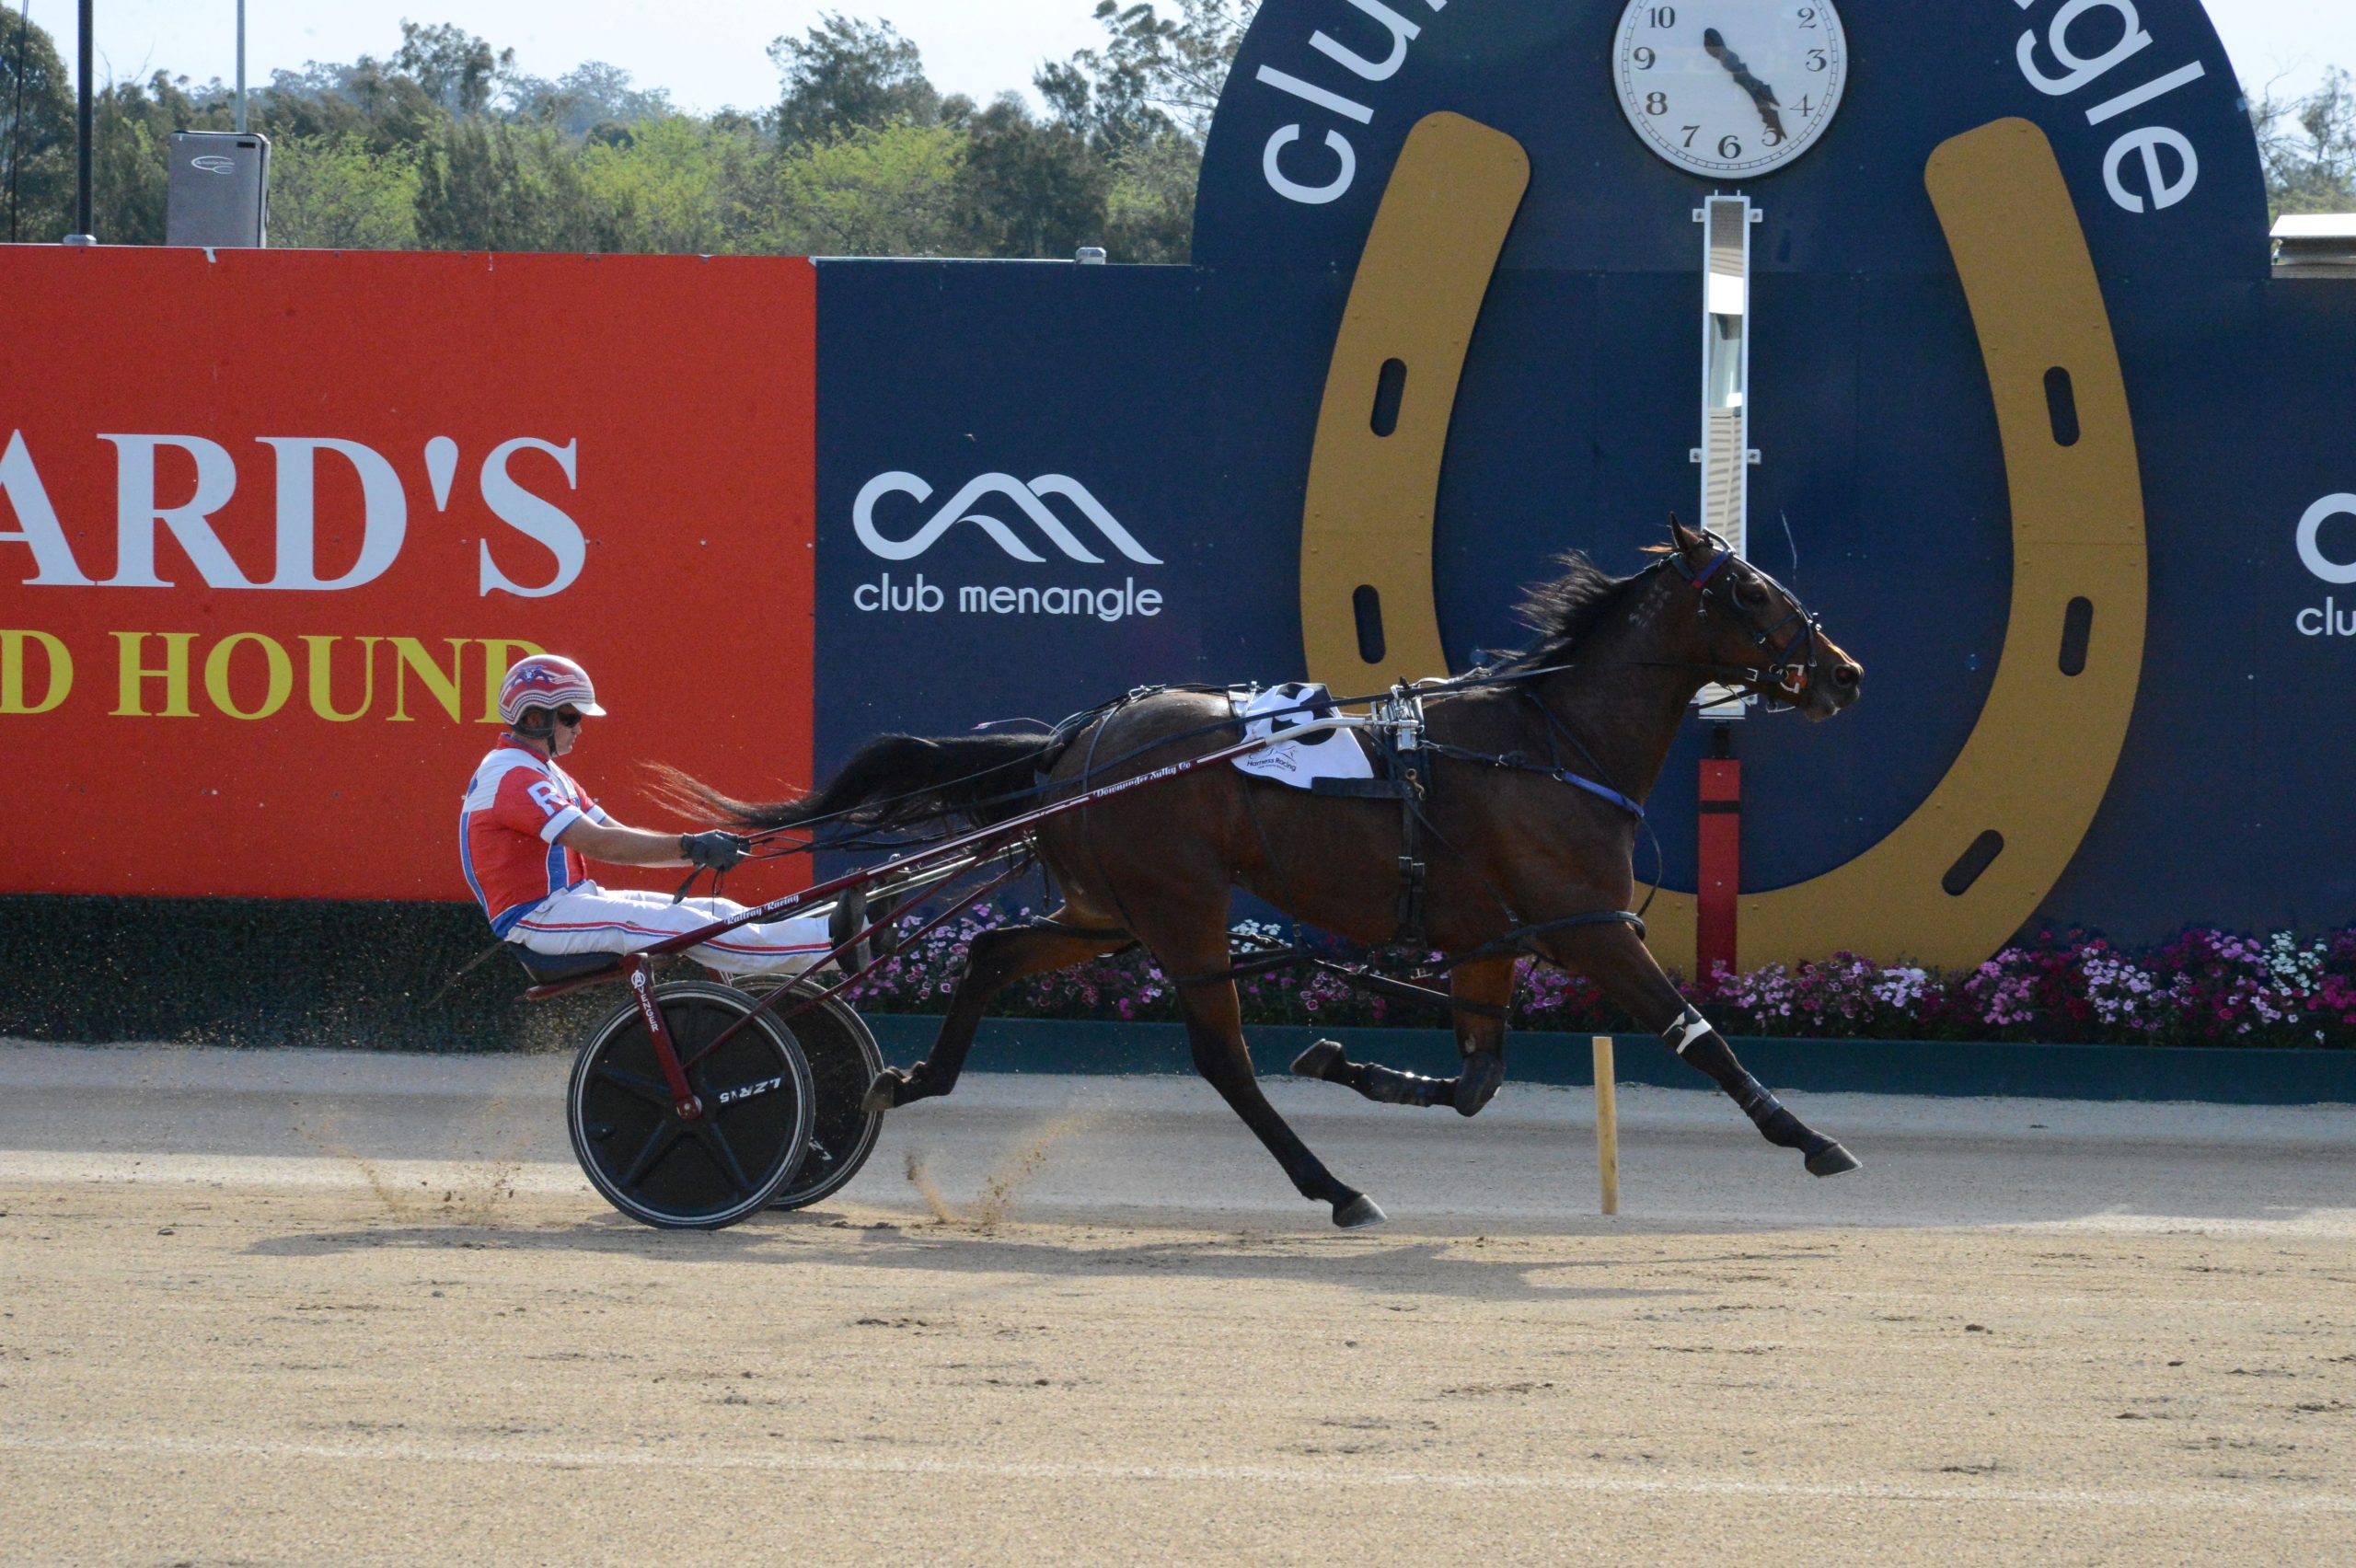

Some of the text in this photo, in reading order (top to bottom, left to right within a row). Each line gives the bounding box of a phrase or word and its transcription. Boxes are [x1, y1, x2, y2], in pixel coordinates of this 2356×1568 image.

[1647, 6, 1676, 29] 10
[1797, 7, 1818, 29] 2
[1634, 47, 1656, 70] 9
[1805, 49, 1827, 72] 3
[1255, 0, 1448, 204] clu
[1646, 92, 1668, 116] 8
[1789, 94, 1815, 117] 4
[2013, 0, 2206, 213] gle
[1680, 125, 1701, 148] 7
[1717, 135, 1742, 159] 6
[853, 573, 1163, 622] club menangle
[1276, 757, 1297, 772] Racing
[526, 781, 569, 816] R
[630, 969, 659, 1032] AVENGER
